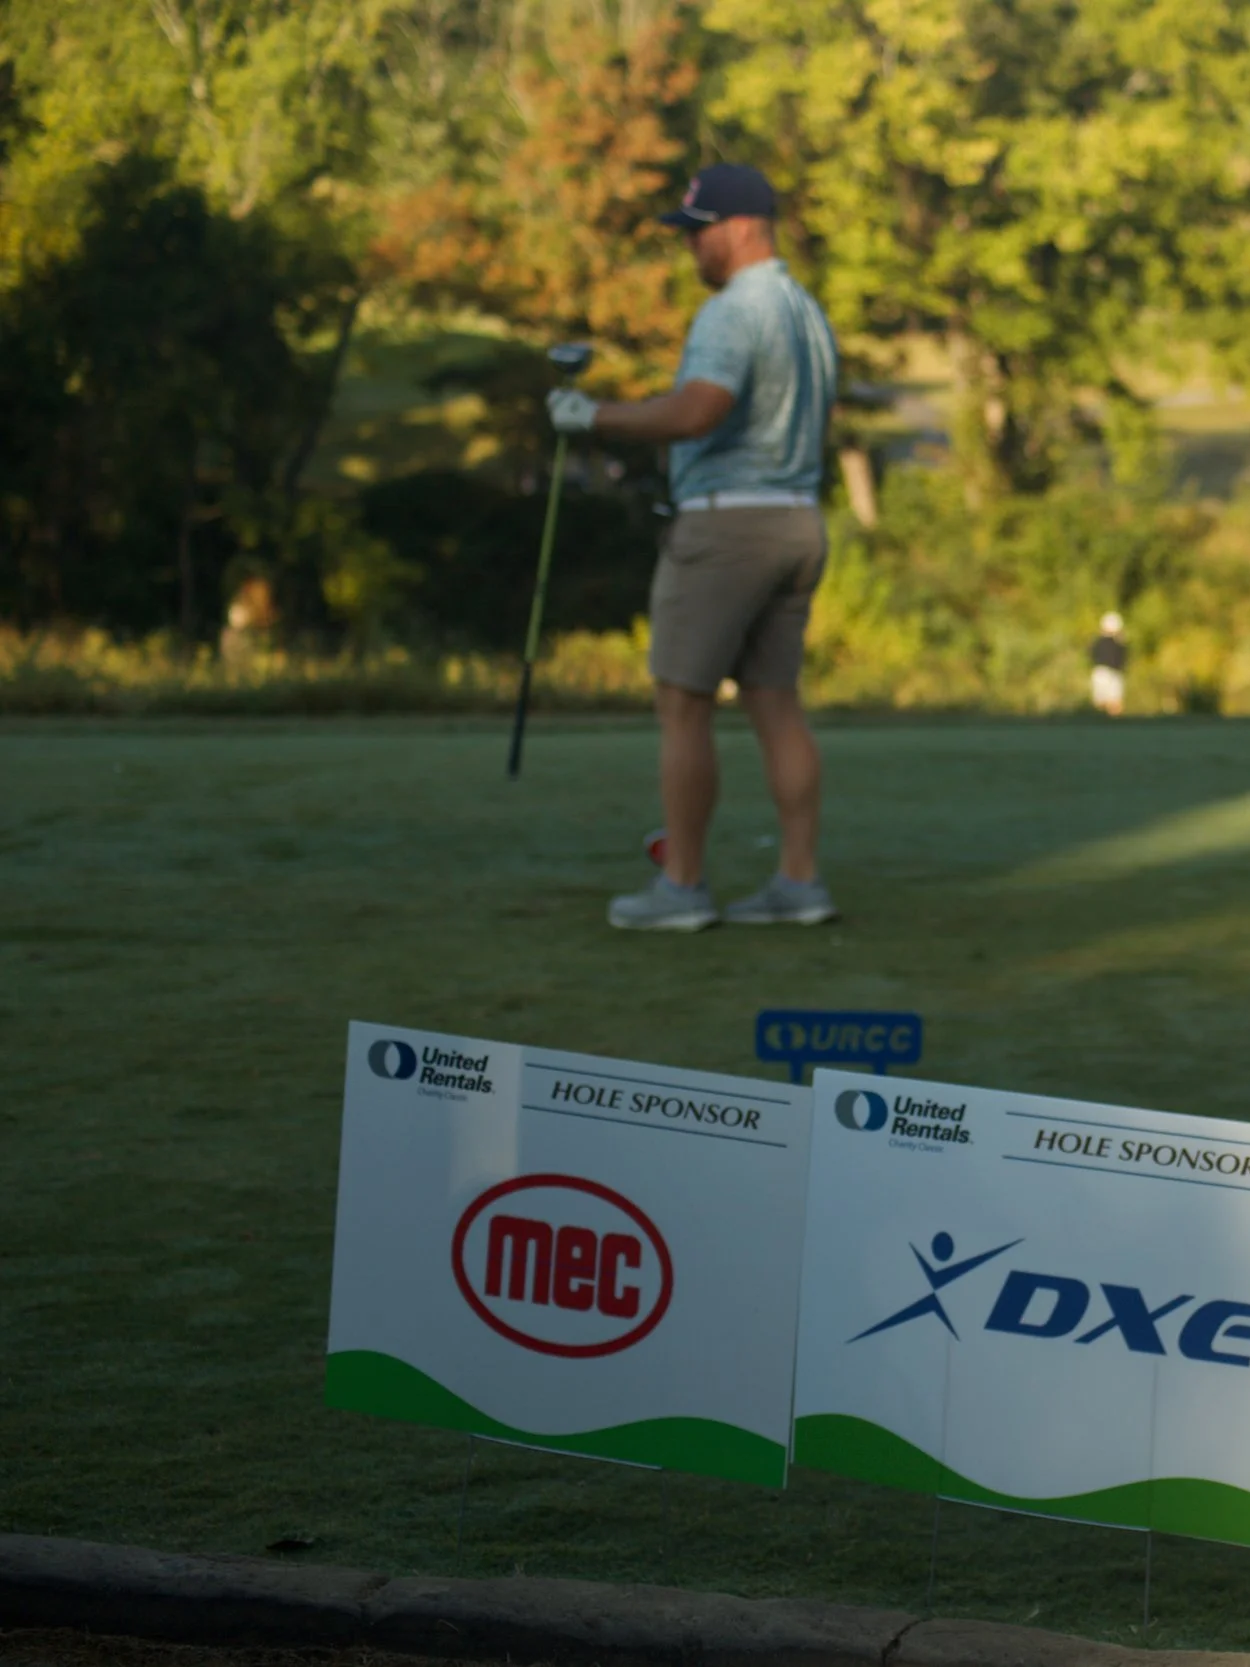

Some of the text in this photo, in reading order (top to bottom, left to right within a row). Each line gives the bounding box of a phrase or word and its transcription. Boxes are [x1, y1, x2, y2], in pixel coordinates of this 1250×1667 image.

[811, 1024, 912, 1053] URCC
[422, 1046, 489, 1073] United
[420, 1066, 493, 1094] Rentals
[551, 1081, 761, 1131] HOLE SPONSOR
[894, 1096, 966, 1122] United
[891, 1117, 970, 1144] Rentals
[1034, 1129, 1110, 1159] HOLE
